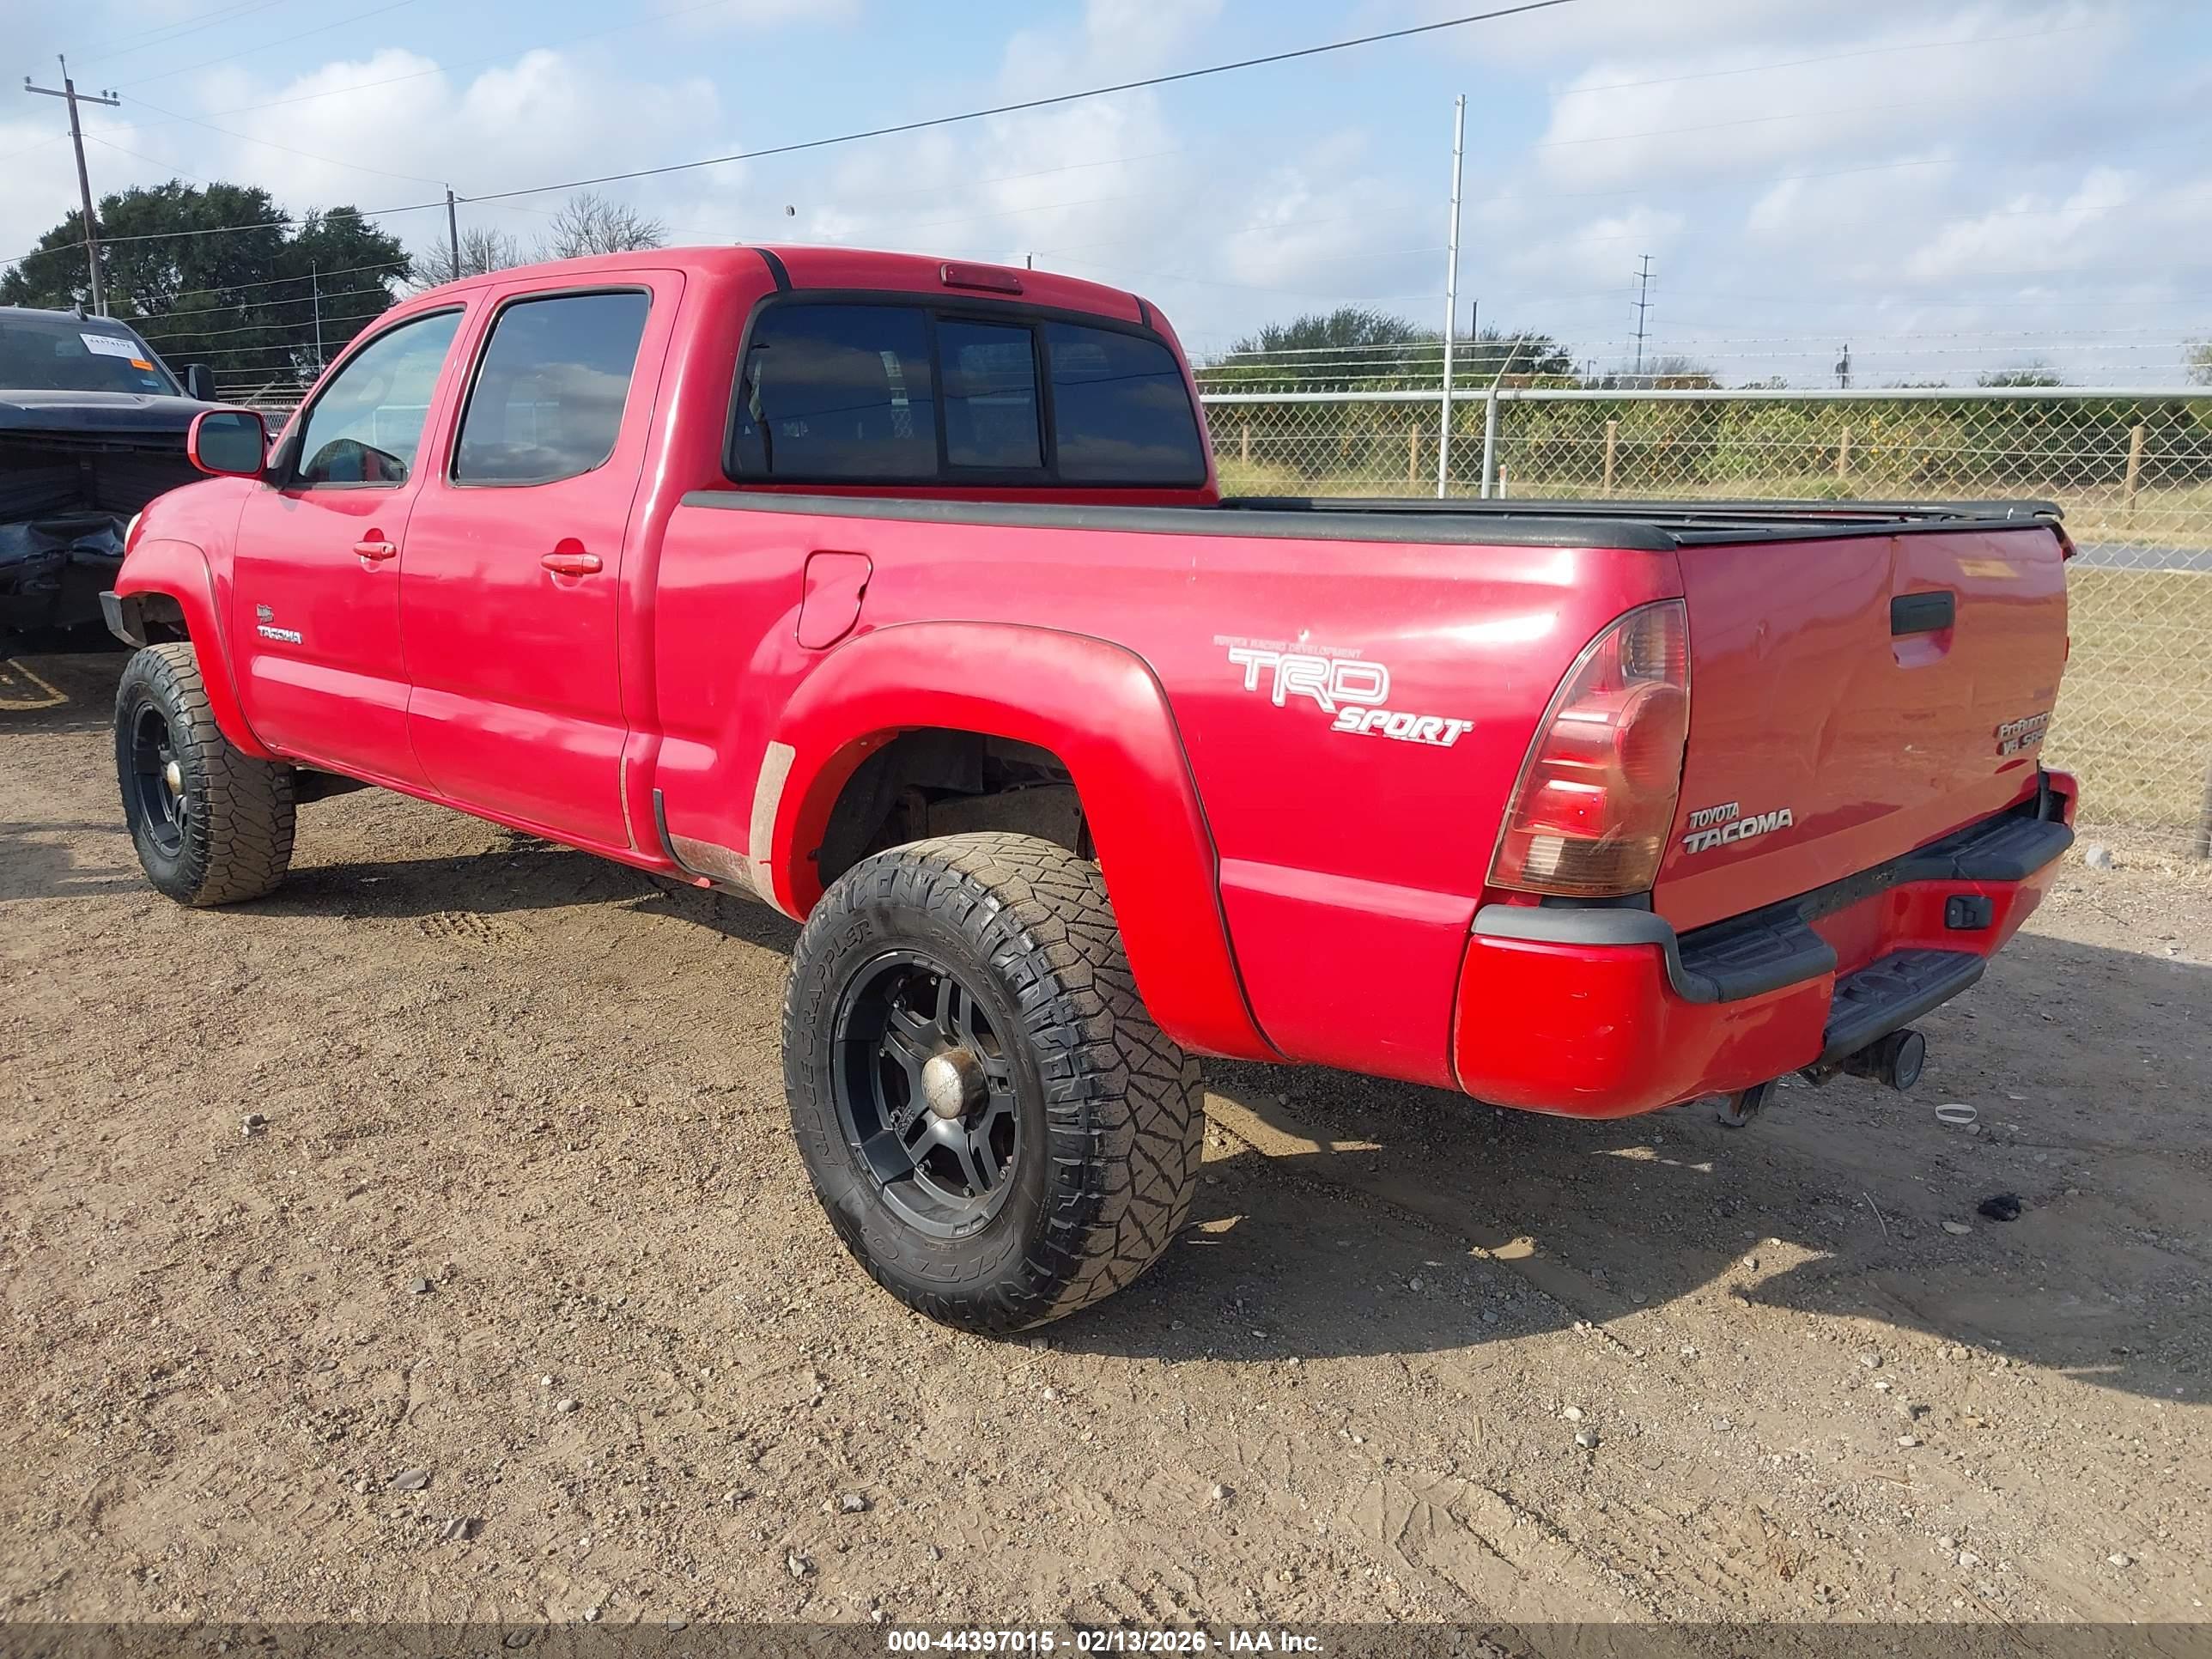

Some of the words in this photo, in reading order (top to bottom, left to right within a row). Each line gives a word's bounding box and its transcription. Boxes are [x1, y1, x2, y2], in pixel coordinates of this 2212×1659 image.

[1288, 641, 1364, 659] DEVELOPMENT
[1228, 647, 1390, 714] TRD
[1331, 706, 1475, 748] SPORT
[1682, 808, 1793, 854] TACOMA
[1689, 802, 1739, 830] TOYOTA
[801, 918, 873, 1056] GRAPPLER
